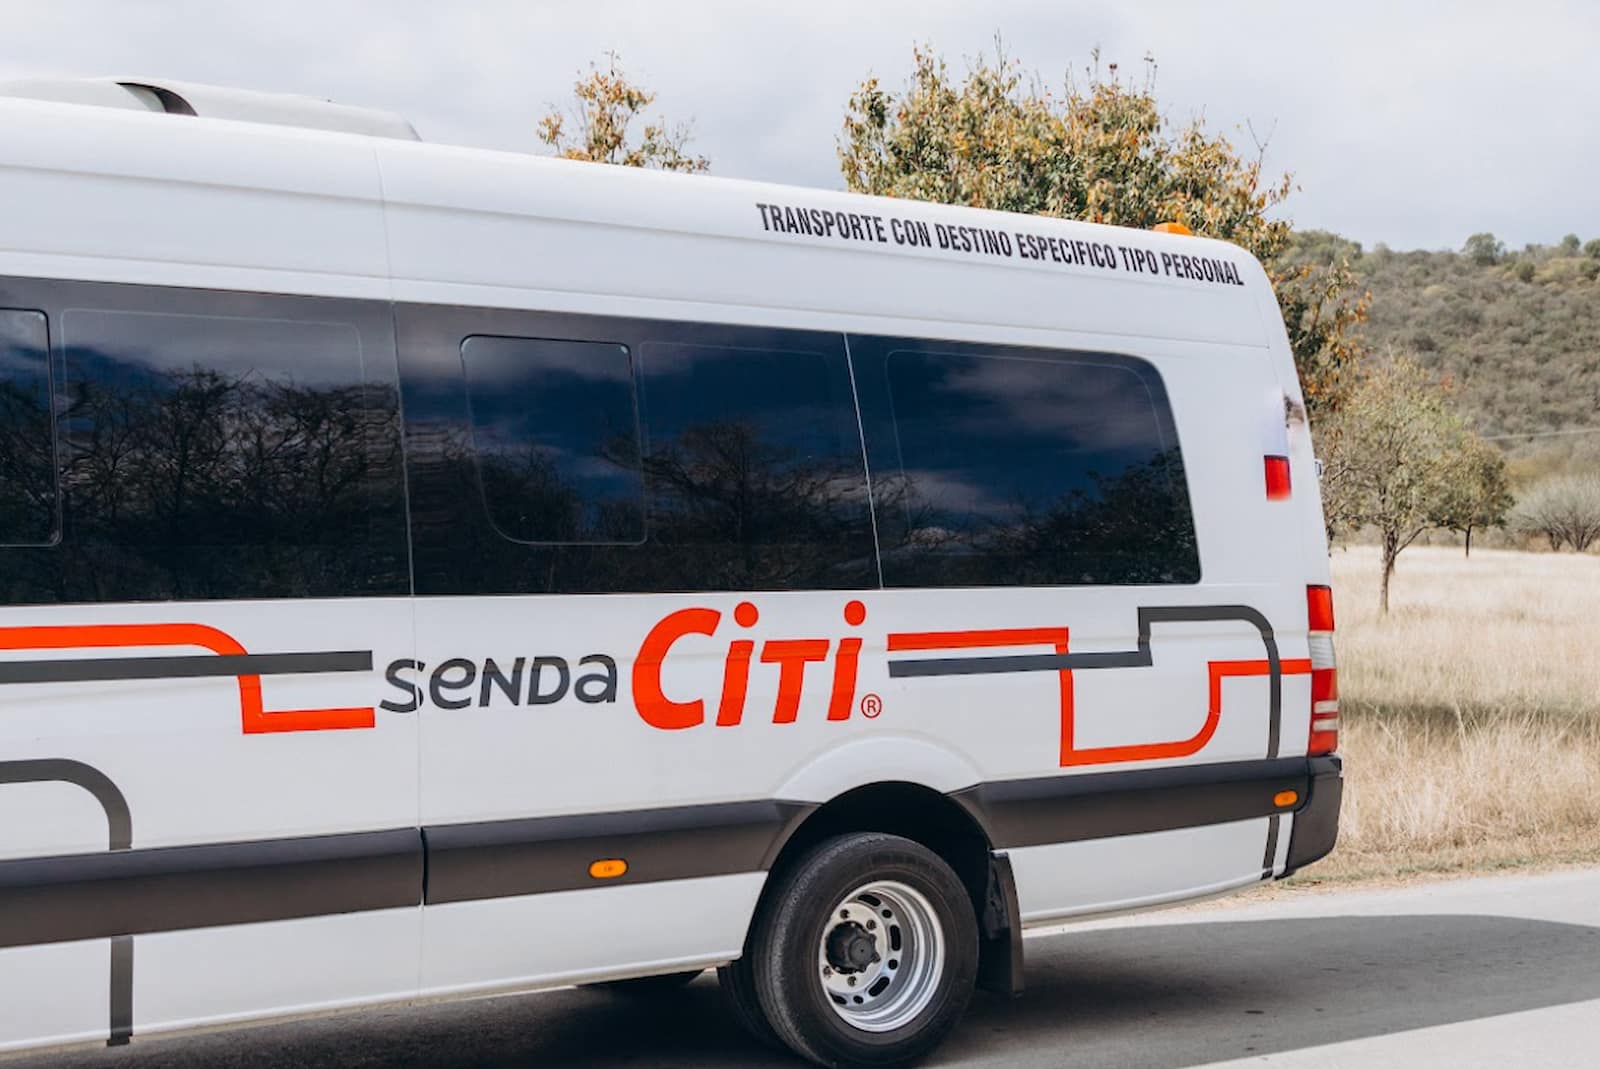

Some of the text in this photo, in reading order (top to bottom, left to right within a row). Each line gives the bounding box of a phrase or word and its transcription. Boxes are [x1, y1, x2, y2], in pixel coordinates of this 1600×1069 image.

[756, 203, 1245, 286] TRANSPORTE CON DESTINO ESPECIFICO TIPO PERSONAL
